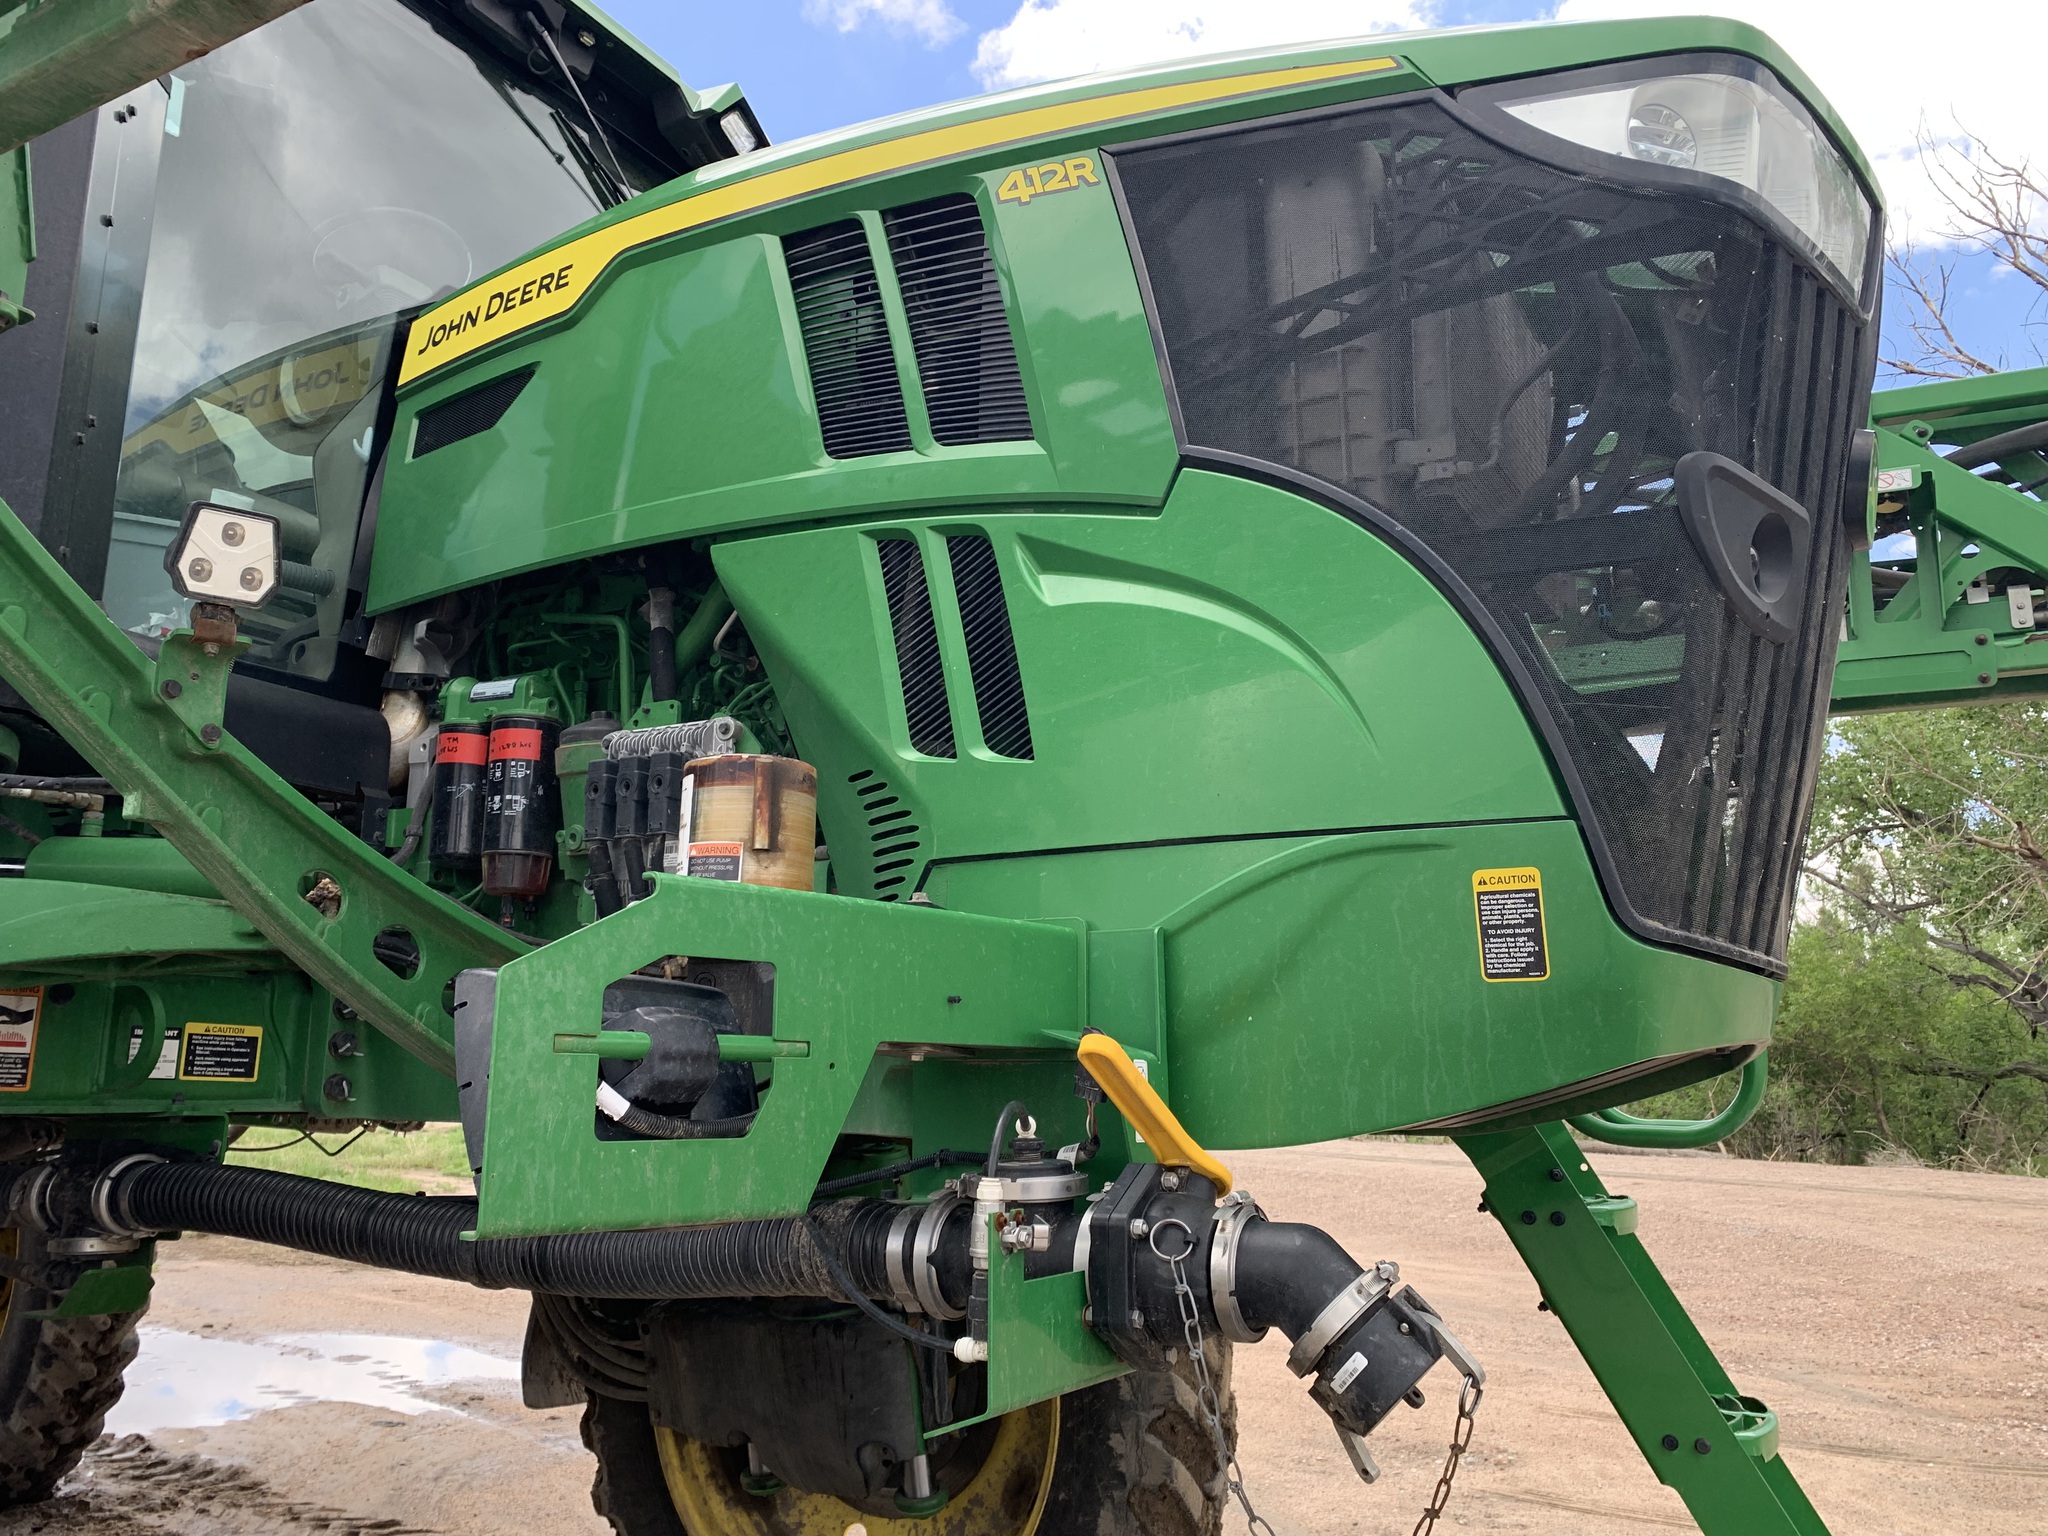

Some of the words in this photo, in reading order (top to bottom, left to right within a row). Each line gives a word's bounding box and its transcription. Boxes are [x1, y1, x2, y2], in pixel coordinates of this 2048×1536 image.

[995, 156, 1101, 207] 412R
[418, 306, 481, 356] JOHN
[484, 264, 573, 322] DEERE
[1489, 875, 1535, 885] CAUTION
